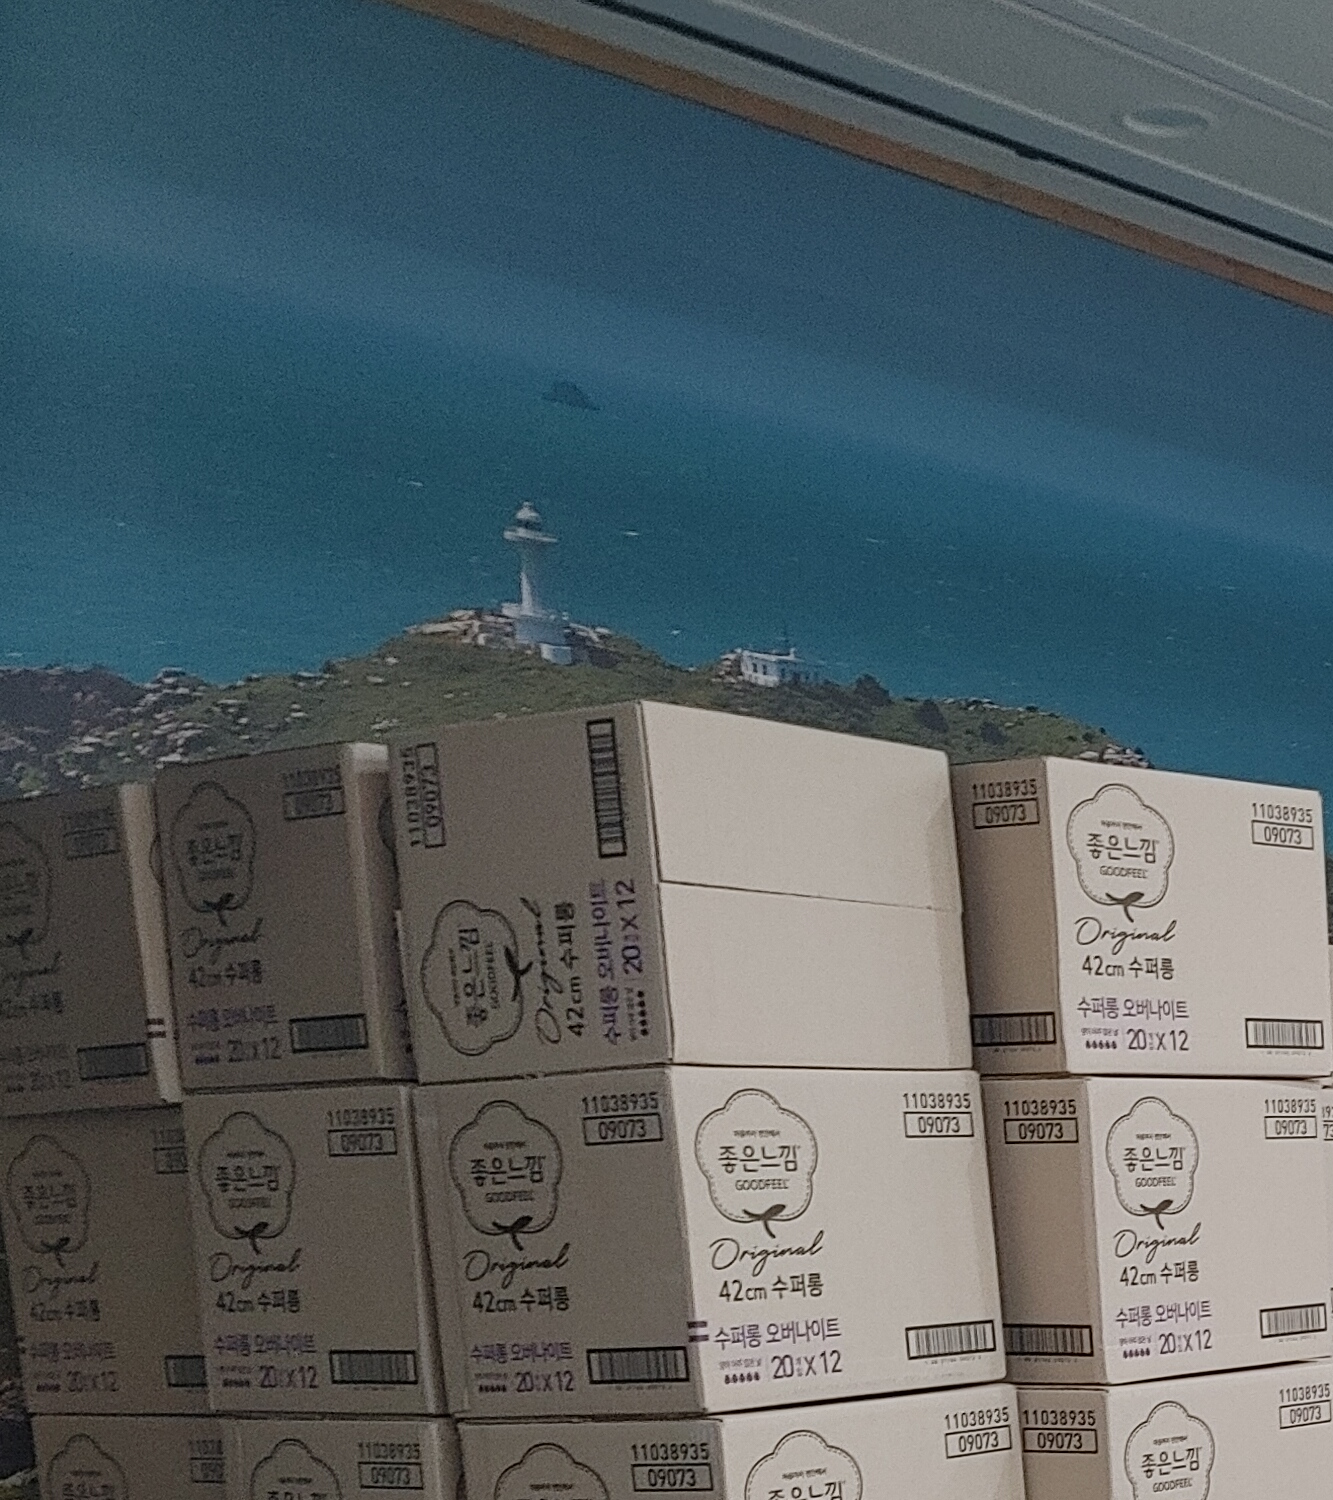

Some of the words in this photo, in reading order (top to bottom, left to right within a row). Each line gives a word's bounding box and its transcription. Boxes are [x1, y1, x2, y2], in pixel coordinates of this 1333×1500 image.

[972, 779, 1037, 801] 11038935
[985, 804, 1027, 825] 09073
[1252, 802, 1314, 824] 11038935
[1264, 827, 1303, 846] 09073
[1086, 832, 1157, 865] 좋은느낌
[1074, 915, 1178, 956] Original
[1082, 956, 1125, 979] 42cm
[1128, 955, 1175, 981] 수퍼롱
[567, 976, 585, 1037] 42cm
[1077, 996, 1119, 1021] 수퍼롱
[1122, 997, 1190, 1022] 오버나이트
[903, 1092, 971, 1111] 11038935
[1004, 1100, 1077, 1117] 11038935
[1264, 1099, 1316, 1114] 11038935
[599, 1118, 647, 1140] 09073
[919, 1116, 961, 1135] 09073
[1018, 1123, 1064, 1141] 09073
[1275, 1120, 1308, 1136] 09073
[717, 1145, 799, 1174] 좋은느낌
[1123, 1145, 1184, 1172] 좋은느낌
[470, 1155, 545, 1187] 좋은느낌
[1113, 1221, 1202, 1264] Original
[709, 1230, 825, 1278] Original
[209, 1247, 302, 1290] Original
[463, 1242, 571, 1290] Original
[1119, 1266, 1157, 1287] 42cm
[1159, 1259, 1200, 1284] 수퍼롱
[718, 1279, 767, 1303] 42cm
[771, 1273, 825, 1299] 수퍼롱
[472, 1291, 517, 1313] 42cm
[1115, 1304, 1151, 1329] 수퍼롱
[1154, 1299, 1212, 1324] 오버나이트
[713, 1323, 763, 1349] 수퍼롱
[766, 1317, 842, 1346] 오버나이트
[1278, 1383, 1331, 1403] 11038935
[944, 1407, 1010, 1430] 11038935
[1022, 1409, 1097, 1426] 11038935
[1289, 1405, 1322, 1424] 09073
[630, 1442, 709, 1462] 11038935
[957, 1431, 1000, 1453] 09073
[1037, 1432, 1083, 1450] 09073
[1141, 1445, 1201, 1478] 좋은느낌
[648, 1467, 697, 1488] 09073
